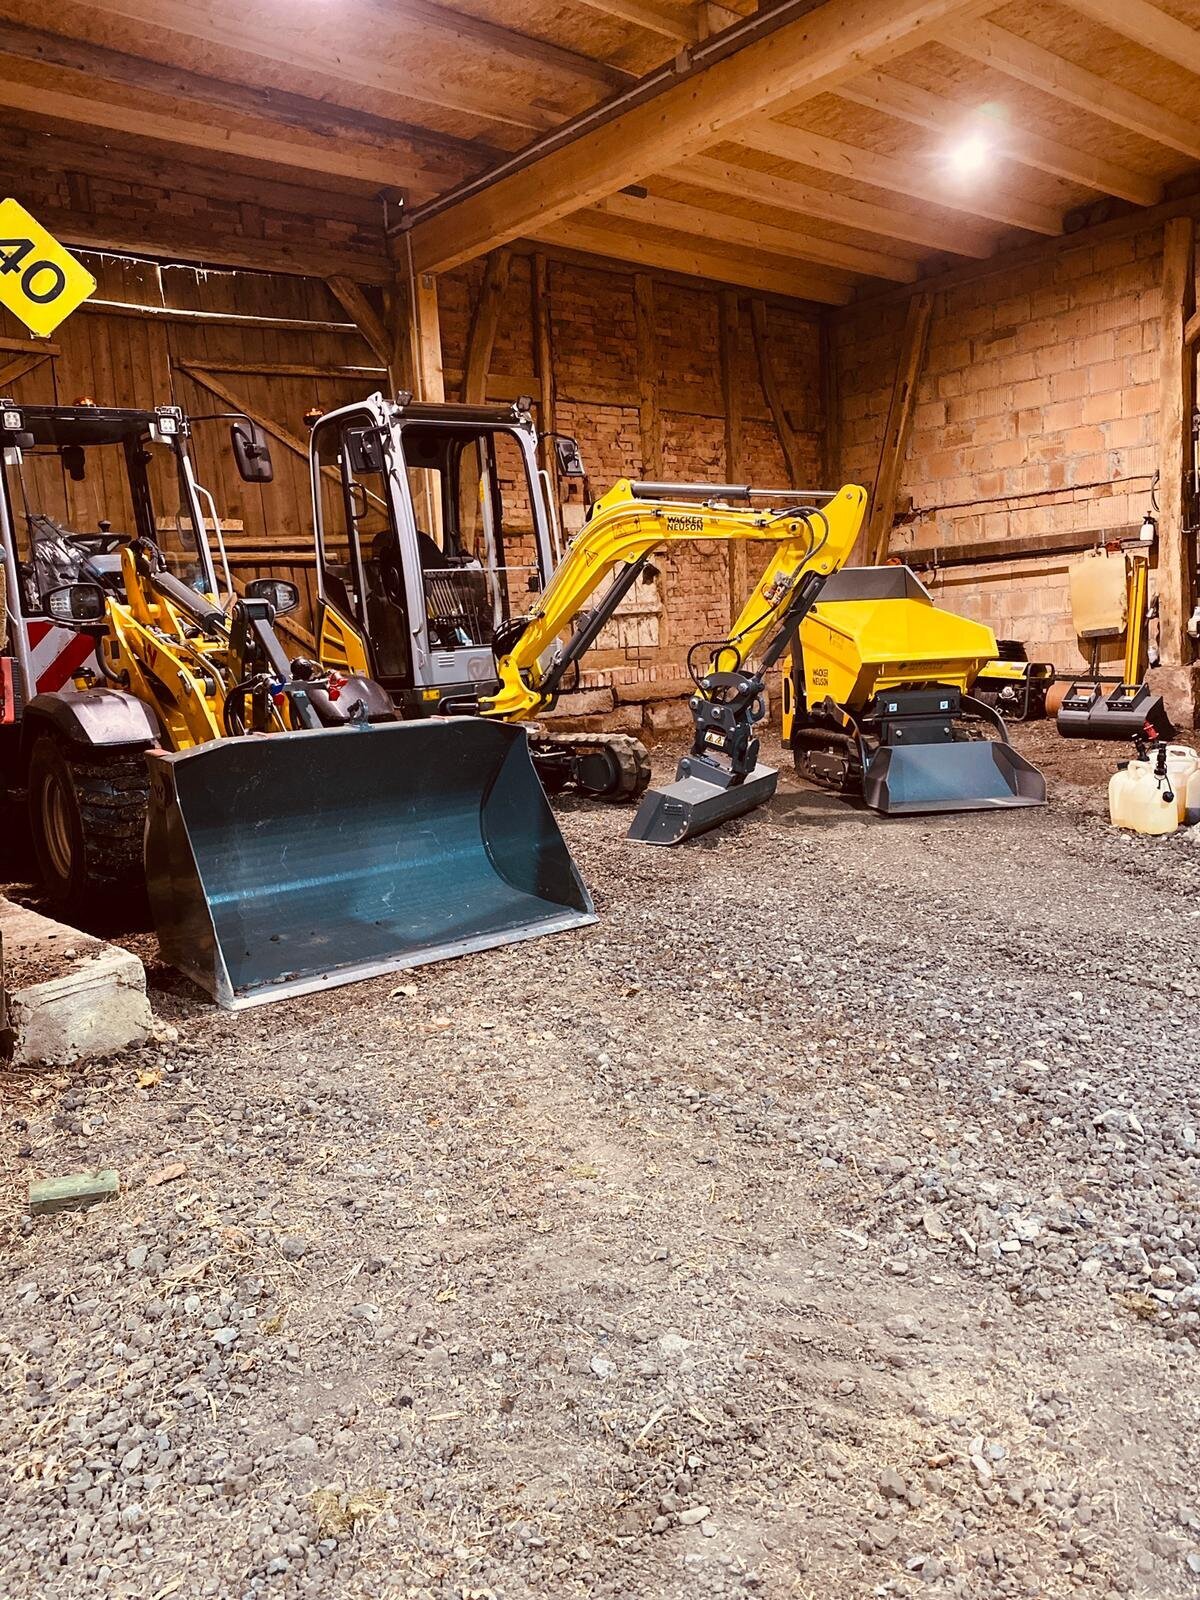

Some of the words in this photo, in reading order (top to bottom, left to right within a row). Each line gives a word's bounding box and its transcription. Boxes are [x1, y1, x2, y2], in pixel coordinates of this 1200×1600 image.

[0, 239, 66, 303] 40
[667, 516, 703, 524] WACKER
[667, 523, 704, 531] NEUSON
